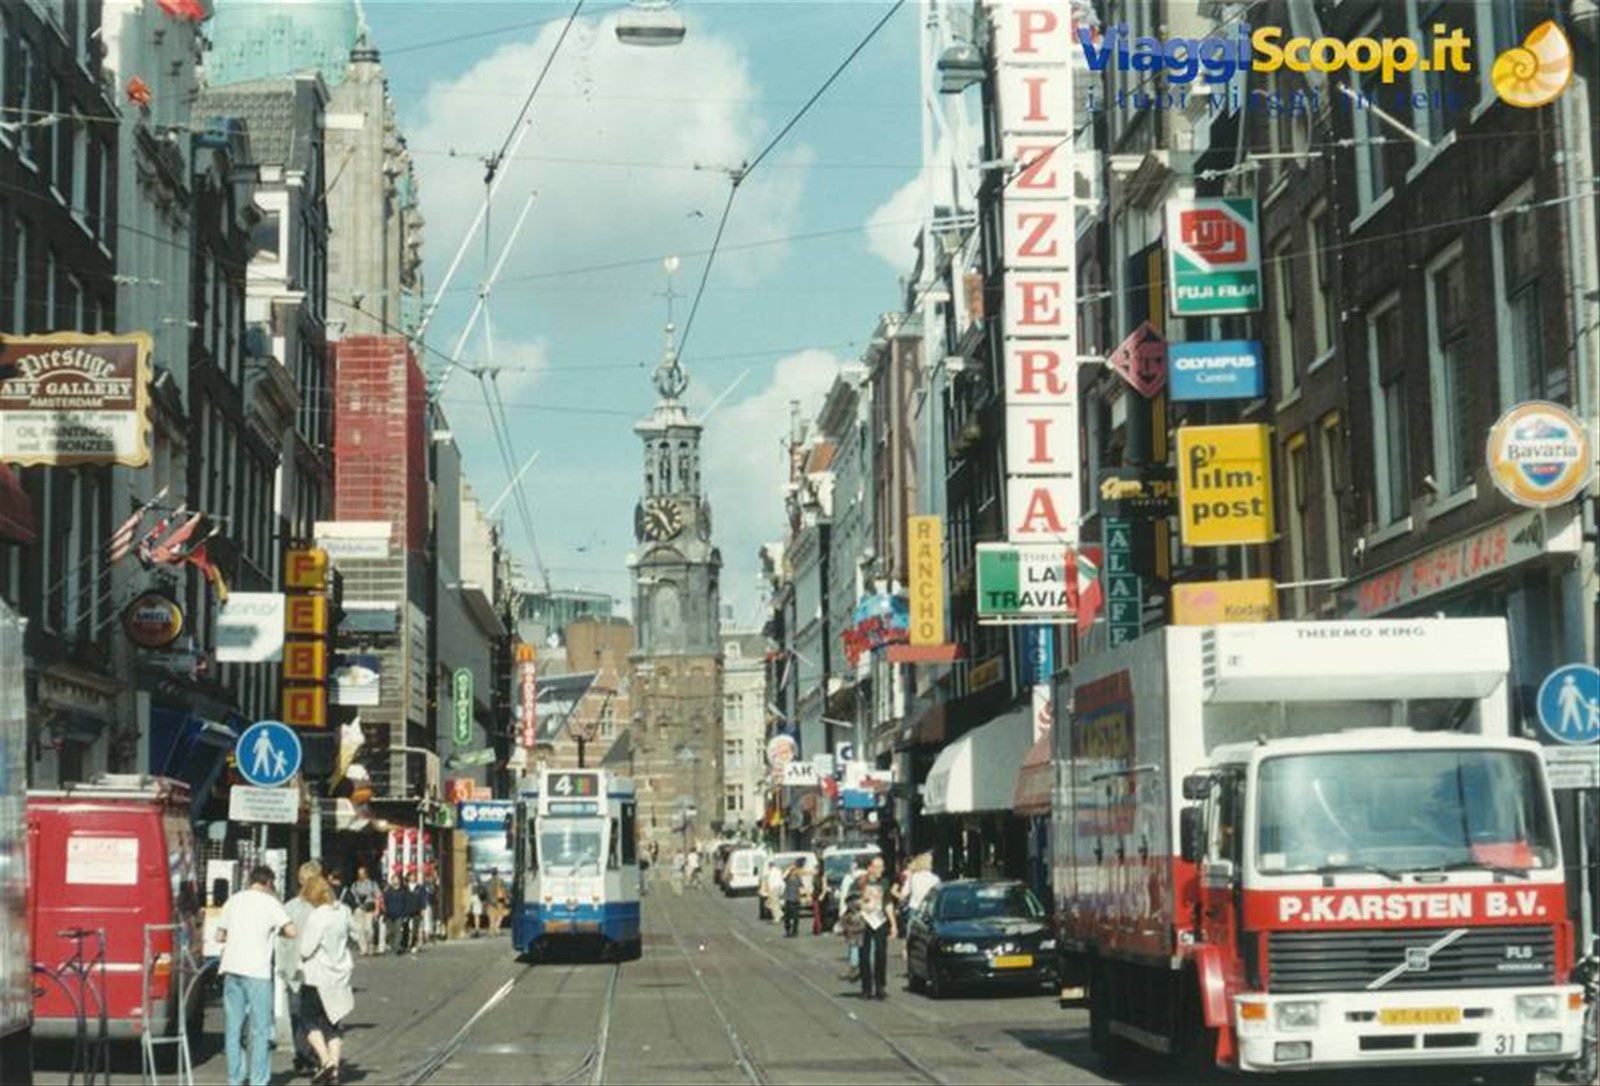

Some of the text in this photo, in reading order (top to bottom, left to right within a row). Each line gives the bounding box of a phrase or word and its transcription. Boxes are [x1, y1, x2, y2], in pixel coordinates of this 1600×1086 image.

[1012, 9, 1068, 534] PIZZERIA
[1177, 283, 1256, 299] FUJI FILM
[16, 348, 117, 380] Prestige
[1174, 354, 1256, 370] OLYMPUS
[0, 382, 131, 396] ART GALLERY
[28, 396, 104, 408] AMSTERDAM
[16, 425, 115, 439] OIL PAINTINGS
[46, 439, 115, 452] BRONZES
[1507, 442, 1579, 462] Bavaria
[1191, 497, 1266, 526] post
[916, 520, 938, 642] RANCHO
[1028, 566, 1058, 583] LA
[291, 553, 316, 720] FEBO
[1295, 626, 1426, 639] THERMO KING
[554, 773, 574, 796] 4
[1278, 889, 1547, 922] P.KARSTEN B.V.
[1493, 1034, 1516, 1055] 31
